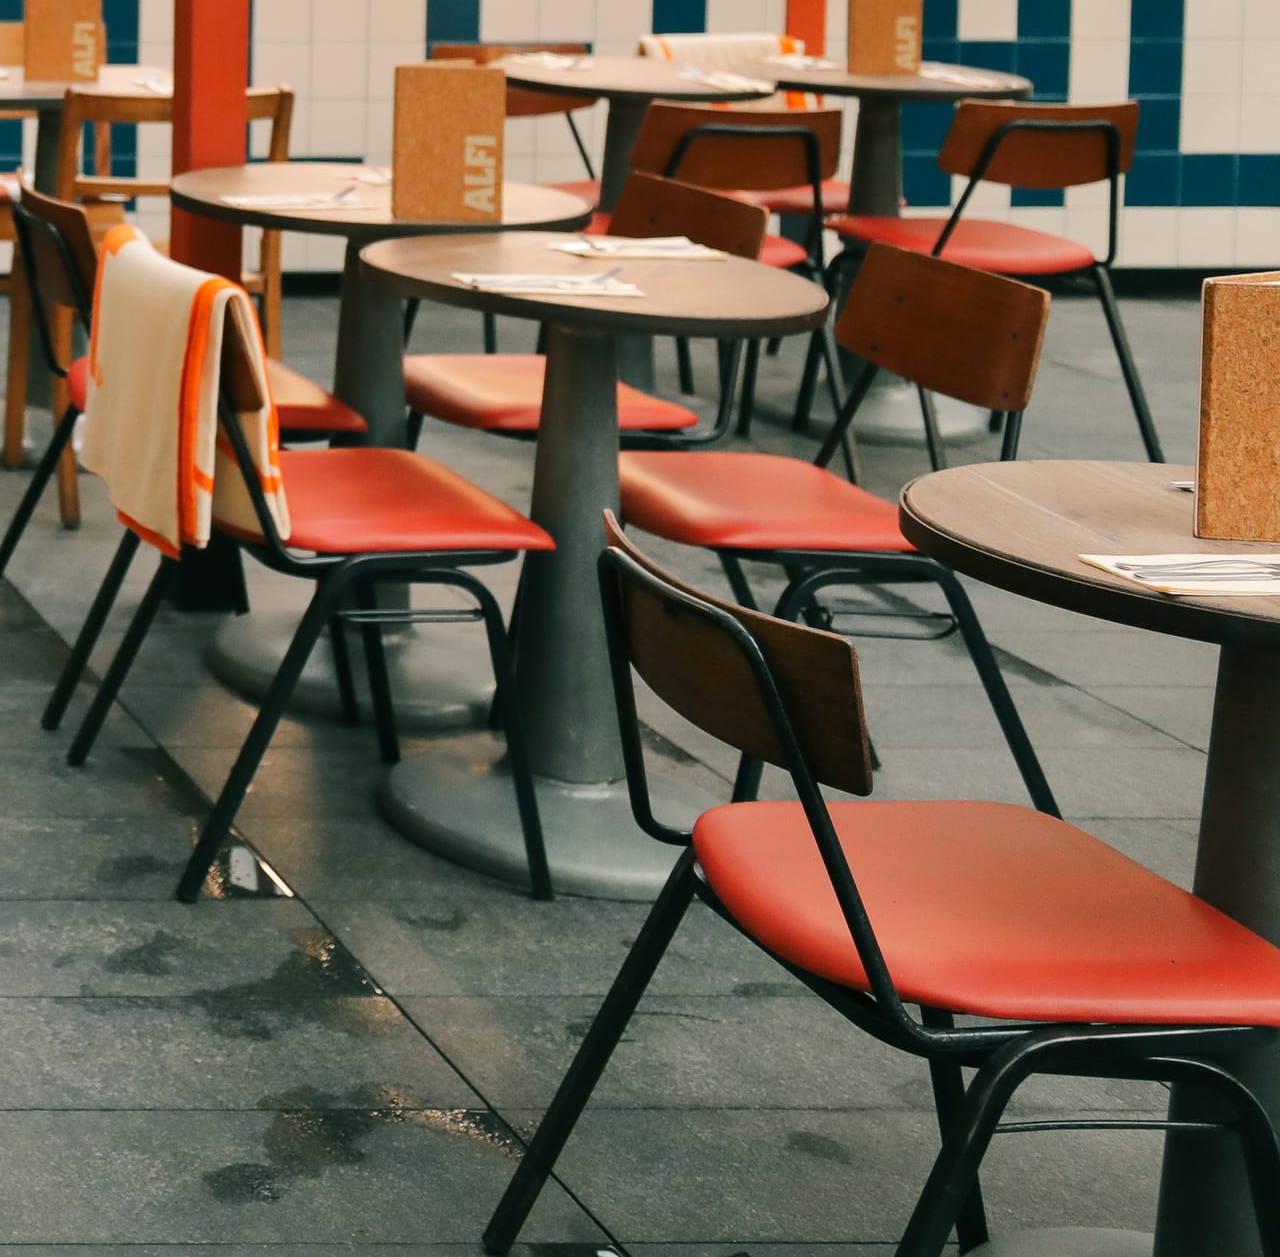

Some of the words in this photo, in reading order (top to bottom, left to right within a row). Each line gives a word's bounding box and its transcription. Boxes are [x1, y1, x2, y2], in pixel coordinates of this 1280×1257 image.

[72, 22, 96, 79] ALFI
[895, 16, 918, 71] ALFI
[463, 135, 497, 214] ALFI
